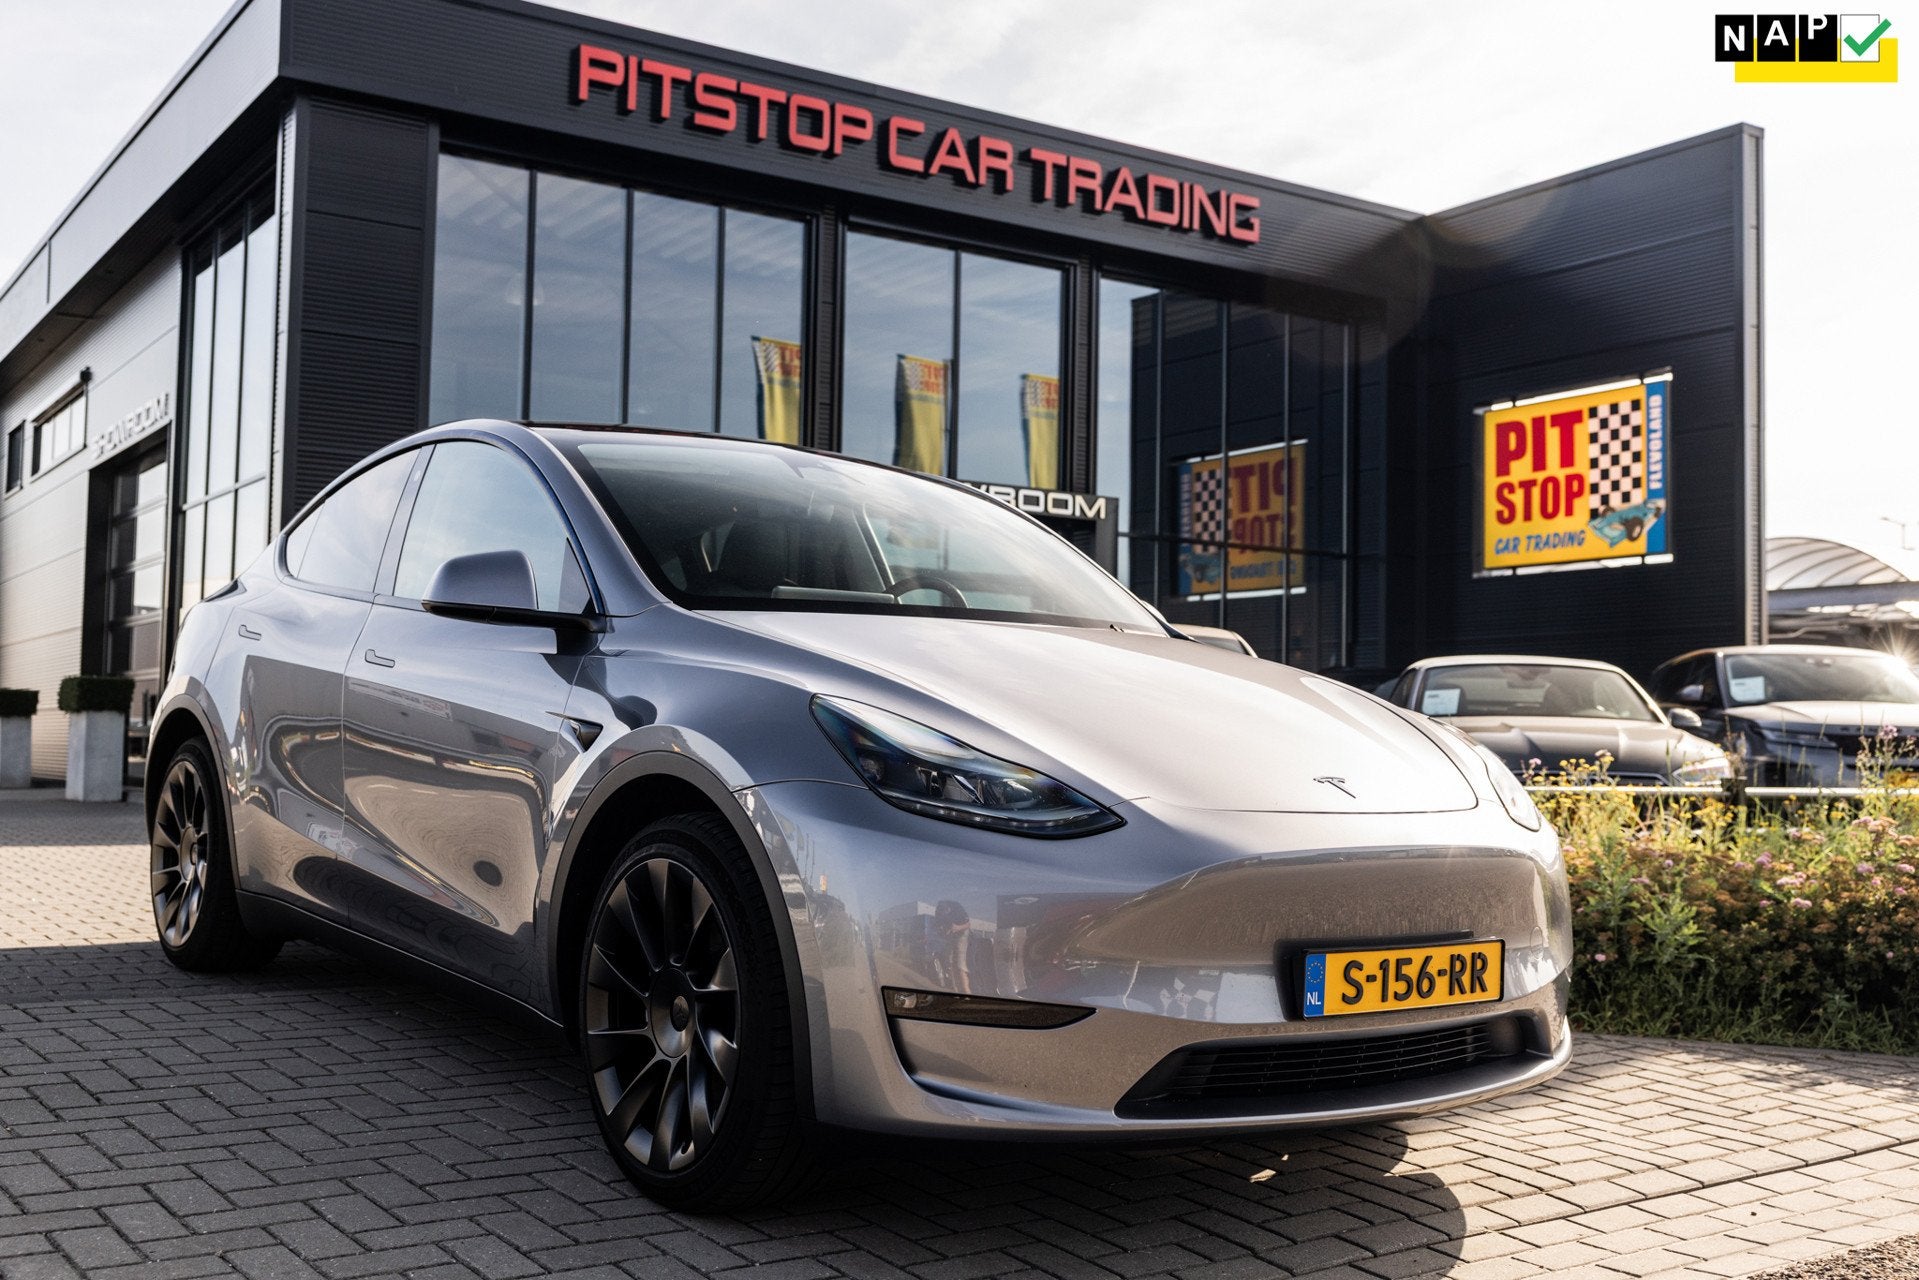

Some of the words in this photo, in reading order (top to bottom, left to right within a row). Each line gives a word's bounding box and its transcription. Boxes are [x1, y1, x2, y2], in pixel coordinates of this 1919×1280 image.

[578, 43, 873, 155] PITSTOP
[888, 115, 1014, 191] CAR
[1029, 147, 1261, 243] TRADING
[1495, 409, 1584, 477] PIT
[963, 482, 1107, 520] ROOM
[1495, 473, 1585, 525] STOP
[1494, 536, 1521, 555] CAR
[1525, 529, 1586, 554] TRADING
[1306, 991, 1322, 1006] NL
[1341, 952, 1489, 1005] S-156-RR
